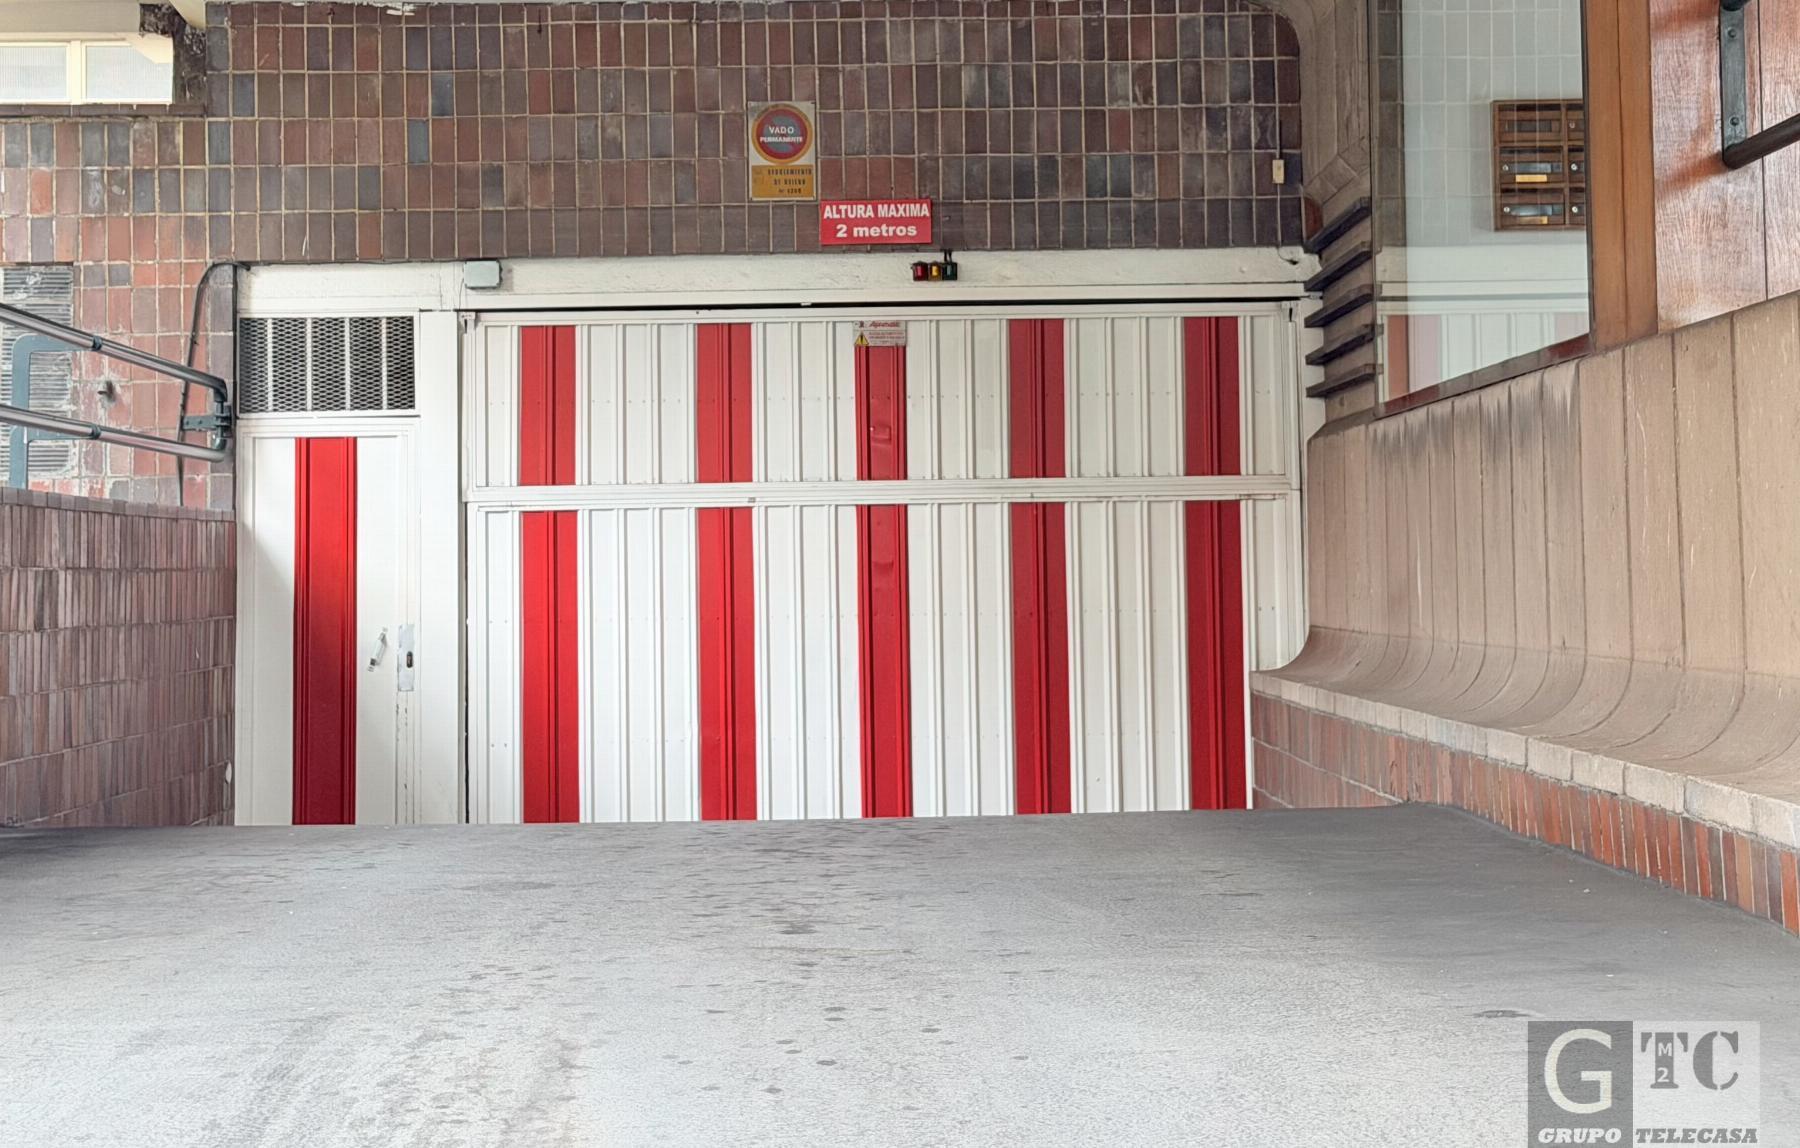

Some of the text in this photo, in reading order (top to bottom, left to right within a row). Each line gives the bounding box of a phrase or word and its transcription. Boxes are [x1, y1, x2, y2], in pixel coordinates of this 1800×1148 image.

[768, 126, 795, 134] VADO
[760, 136, 803, 144] PERMANENTE
[823, 203, 930, 219] ALTURA MAXIMA
[836, 223, 918, 238] 2 metros
